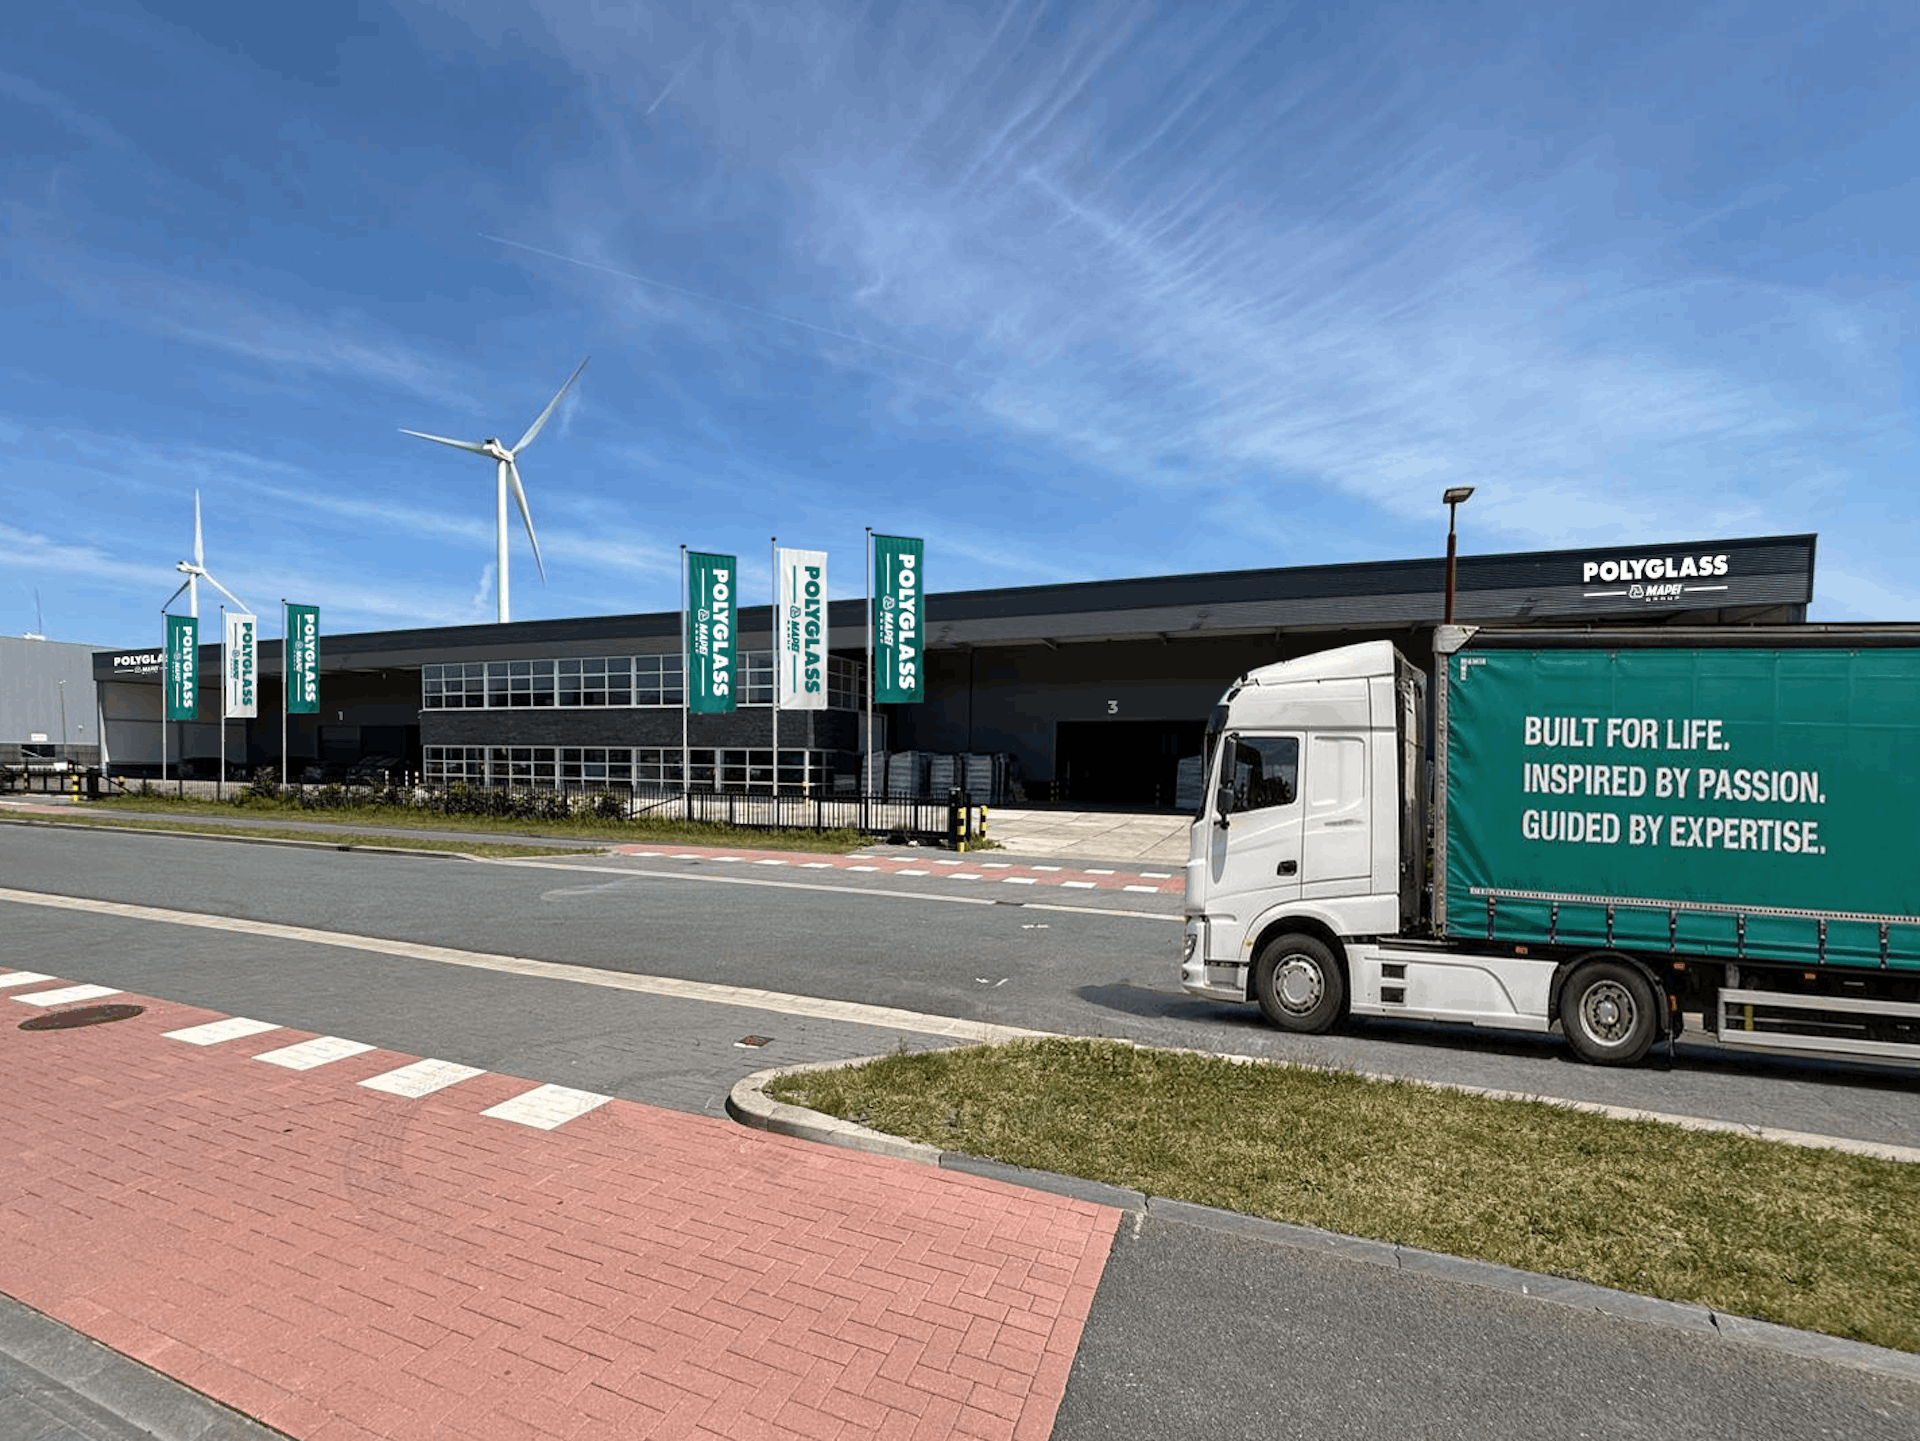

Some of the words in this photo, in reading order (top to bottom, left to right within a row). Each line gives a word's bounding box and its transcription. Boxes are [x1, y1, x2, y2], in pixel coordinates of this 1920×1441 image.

[1583, 554, 1729, 582] POLYGLASS
[1645, 583, 1682, 597] MAPEI
[712, 568, 729, 697] POLYGLASS
[804, 566, 820, 694] POLYGLASS
[898, 553, 915, 690] POLYGLASS
[114, 653, 168, 667] POLYGLA
[182, 625, 193, 708] POLYGLASS
[243, 622, 253, 706] POLYGLASS
[304, 613, 316, 703] POLYGLASS
[337, 710, 344, 721] 1
[1107, 700, 1118, 714] 3
[1524, 716, 1599, 747] BUILT
[1606, 718, 1659, 749] FOR
[1666, 718, 1730, 750] LIFE.
[1523, 763, 1647, 797] INSPIRED
[1655, 767, 1691, 799] BY
[1698, 769, 1826, 804] PASSION.
[1522, 809, 1621, 844] GUIDED
[1629, 814, 1664, 847] BY
[1670, 816, 1826, 855] EXPERTISE.
